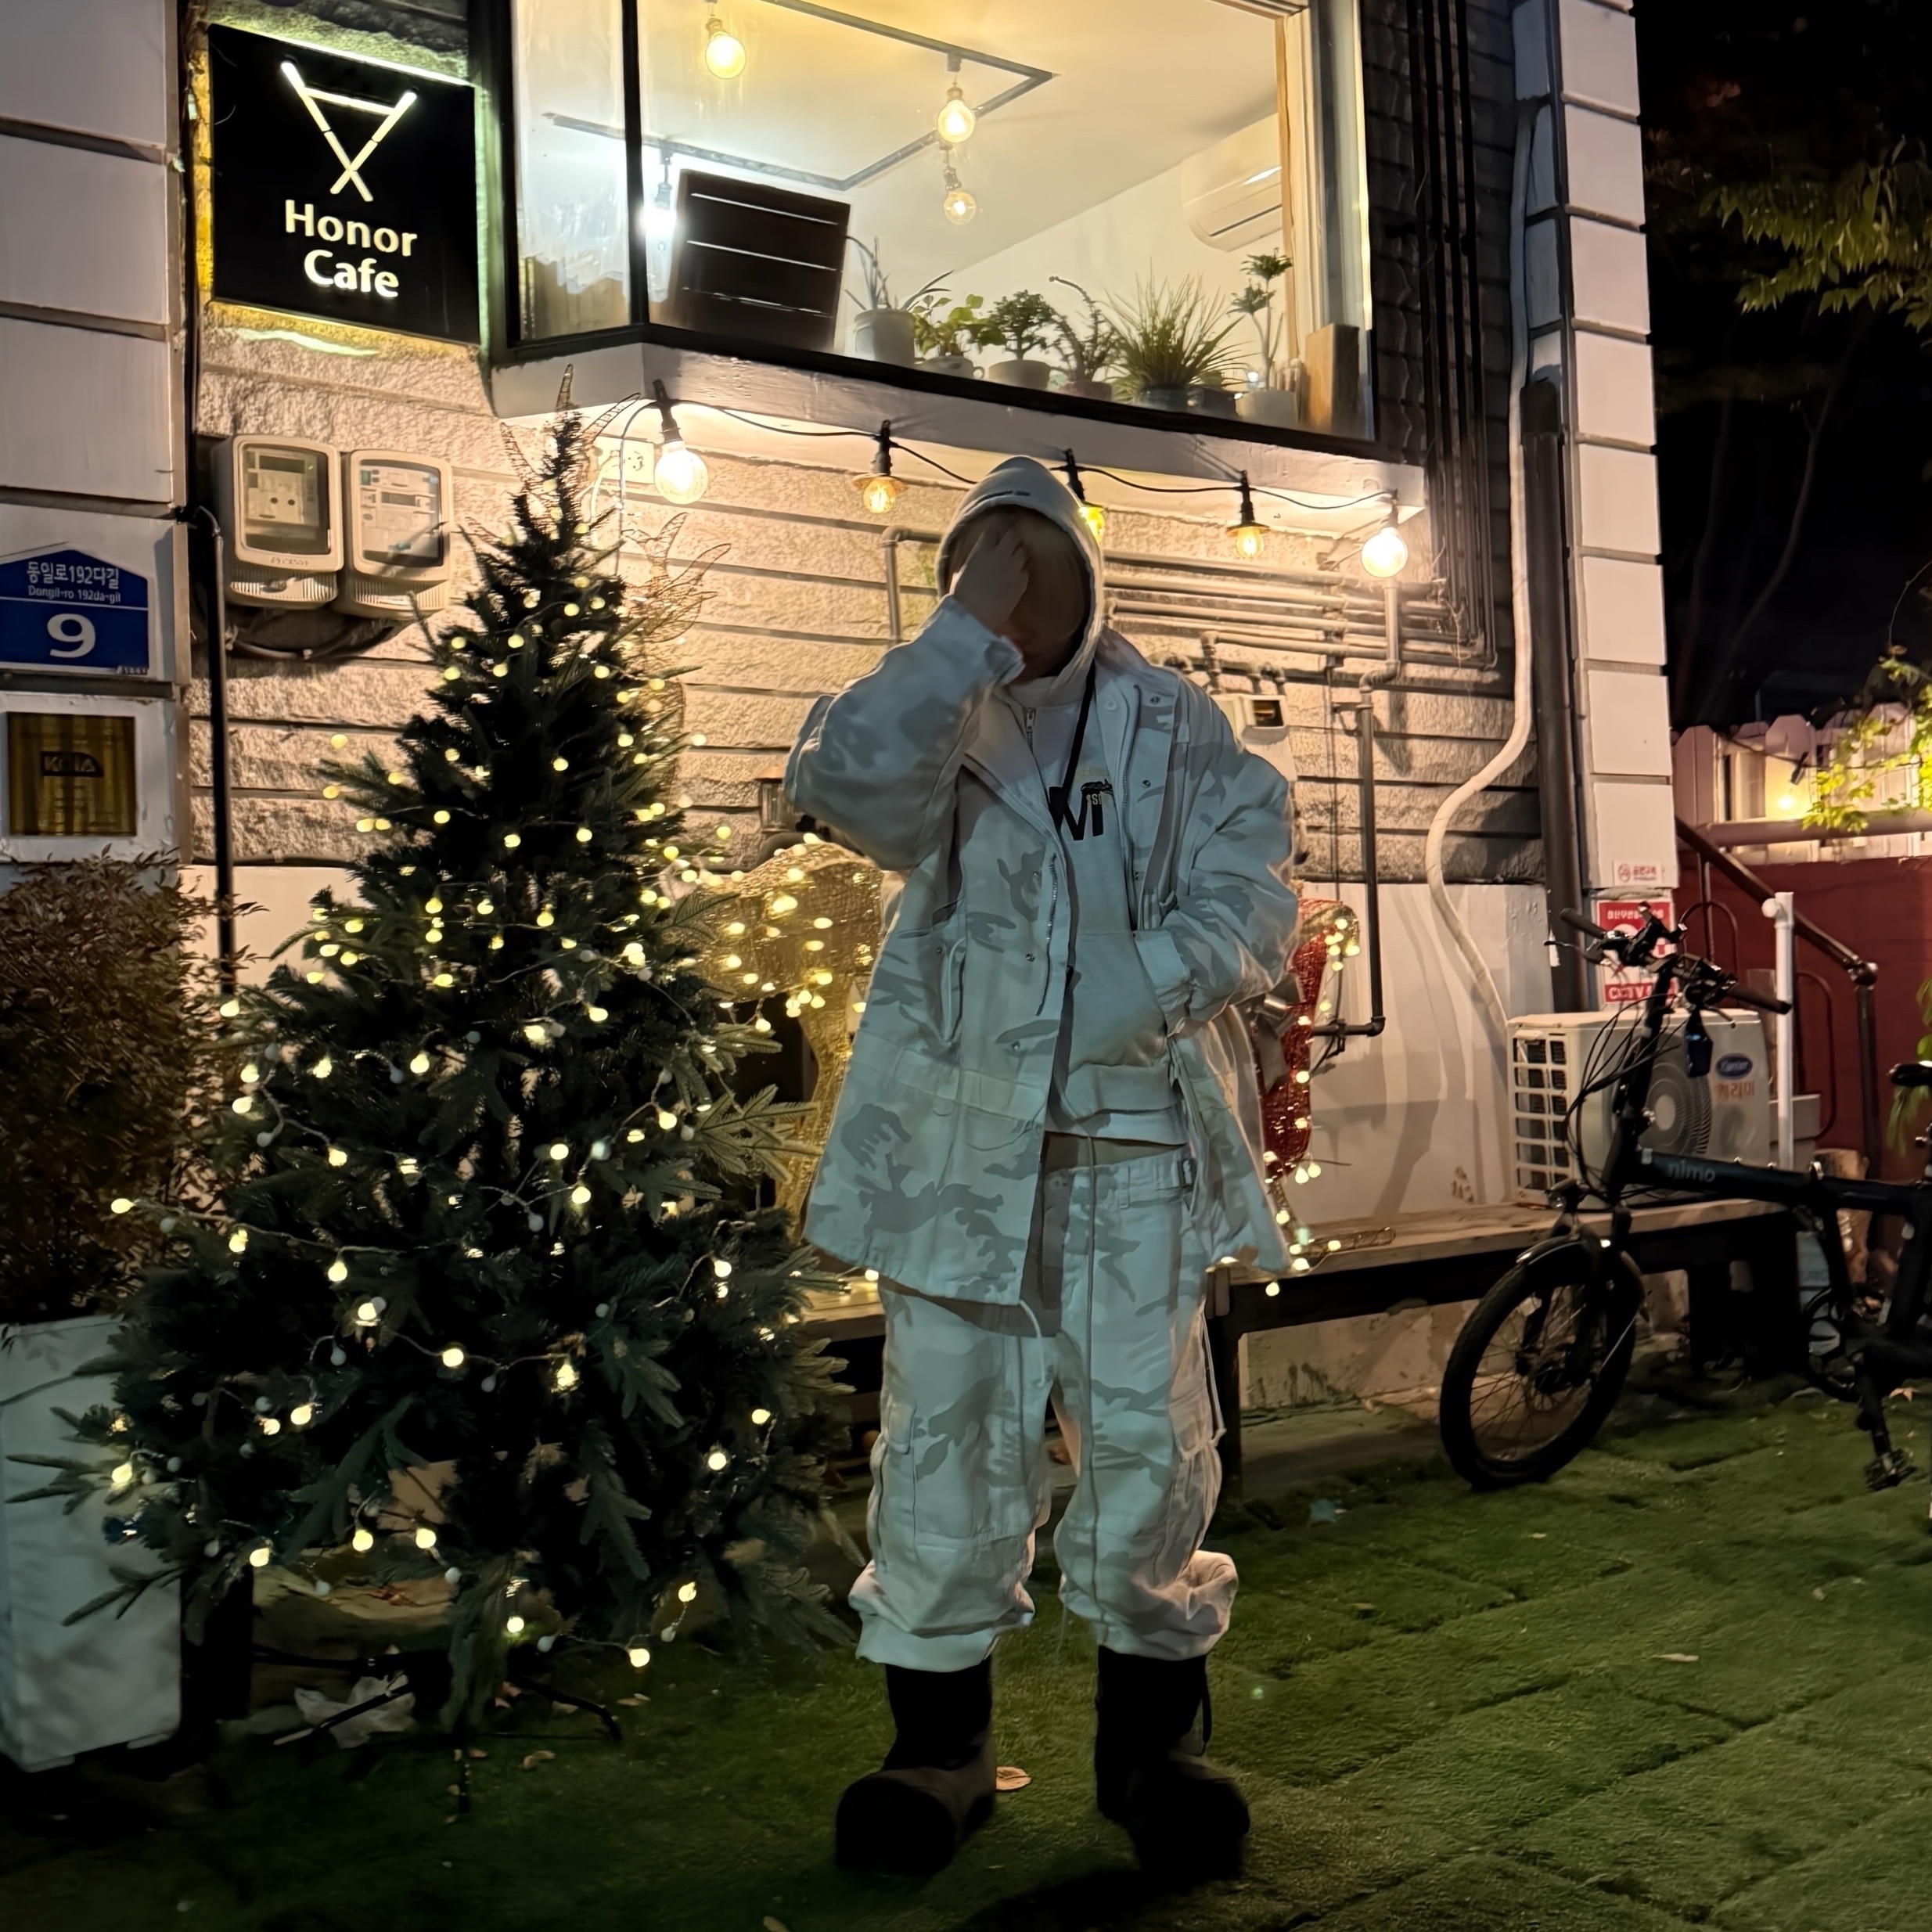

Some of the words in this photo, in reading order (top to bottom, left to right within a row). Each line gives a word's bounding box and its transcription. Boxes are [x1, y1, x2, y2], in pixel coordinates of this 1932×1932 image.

[285, 199, 418, 257] Honor
[304, 249, 399, 298] Cafe
[27, 561, 120, 589] 동일로192다길
[27, 585, 74, 600] Dongil-ro
[77, 588, 121, 604] 192da-gil
[47, 613, 96, 659] 9
